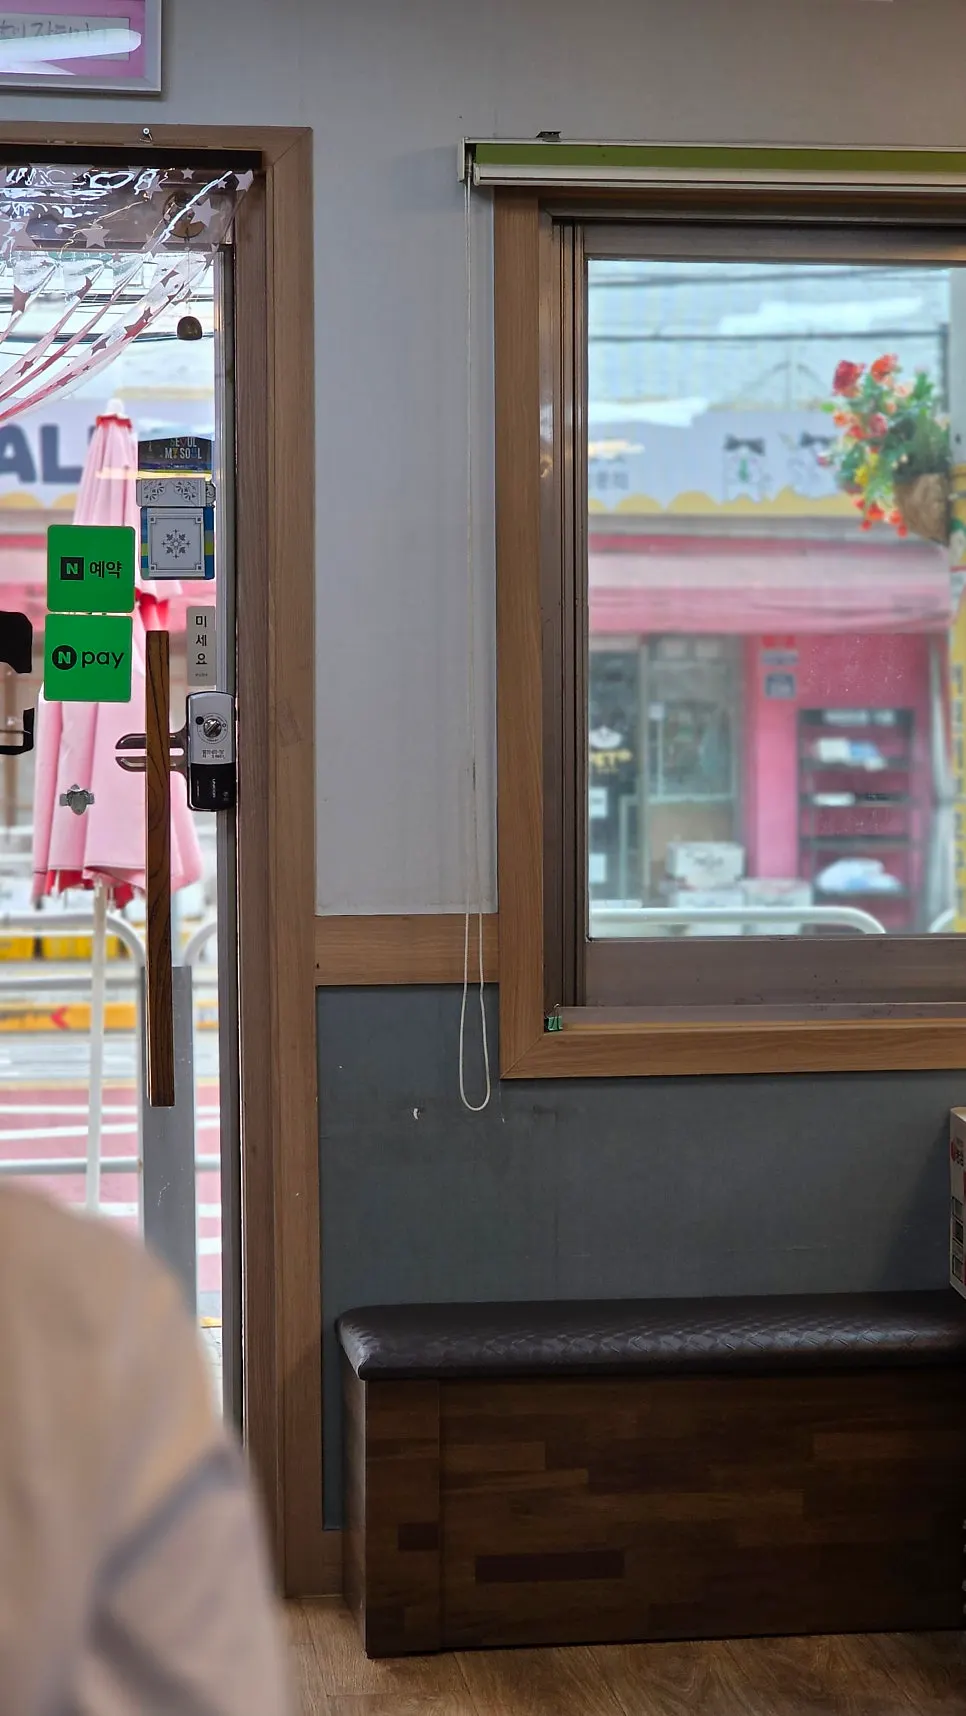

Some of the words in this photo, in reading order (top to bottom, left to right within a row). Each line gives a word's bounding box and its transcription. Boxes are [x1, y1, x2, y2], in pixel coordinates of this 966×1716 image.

[0, 423, 97, 485] AL
[180, 448, 202, 459] SOUL
[89, 560, 122, 578] 예약
[195, 615, 208, 665] 미세요
[82, 651, 124, 669] pay
